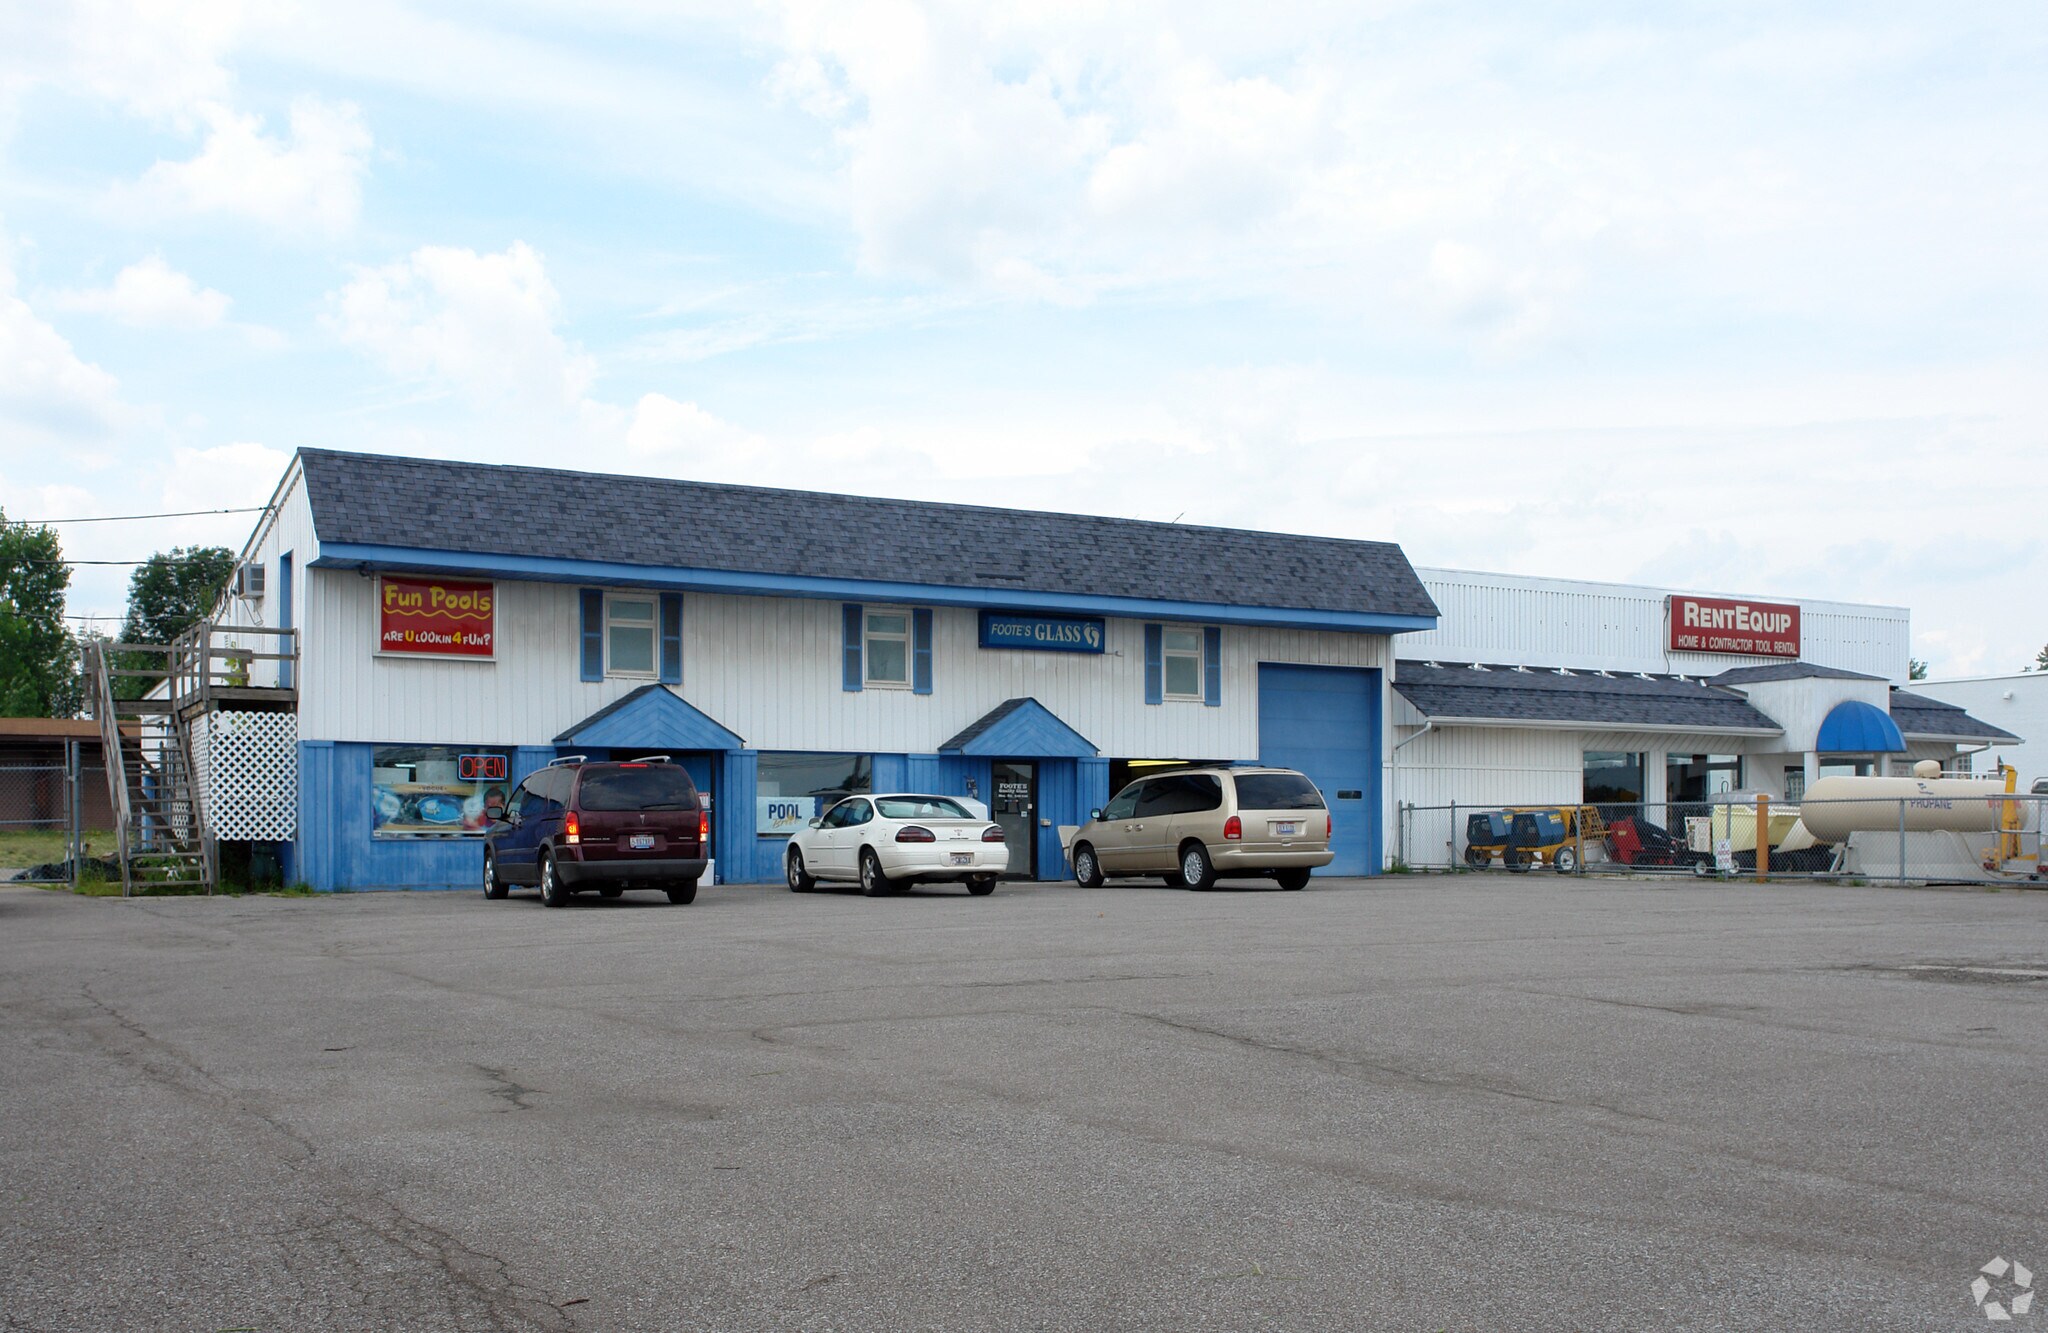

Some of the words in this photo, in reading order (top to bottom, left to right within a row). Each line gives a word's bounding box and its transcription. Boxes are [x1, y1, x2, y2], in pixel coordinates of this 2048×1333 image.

[384, 585, 422, 607] Fun
[429, 586, 491, 612] Pools
[383, 631, 403, 642] ARE
[405, 630, 414, 642] U
[415, 631, 452, 644] LOOKIN
[452, 632, 461, 644] 4
[463, 633, 491, 646] FUN?
[991, 623, 1031, 637] FOOTE'S
[1034, 623, 1081, 642] GLASS
[1678, 634, 1698, 648] HOME
[1701, 636, 1706, 648] &
[1709, 636, 1752, 651] CONTRACTOR
[1755, 639, 1772, 653] TOOL
[1774, 641, 1797, 654] RENTAL
[460, 756, 504, 778] OPEN
[768, 803, 802, 819] POOL
[1910, 798, 1952, 809] PROPANE
